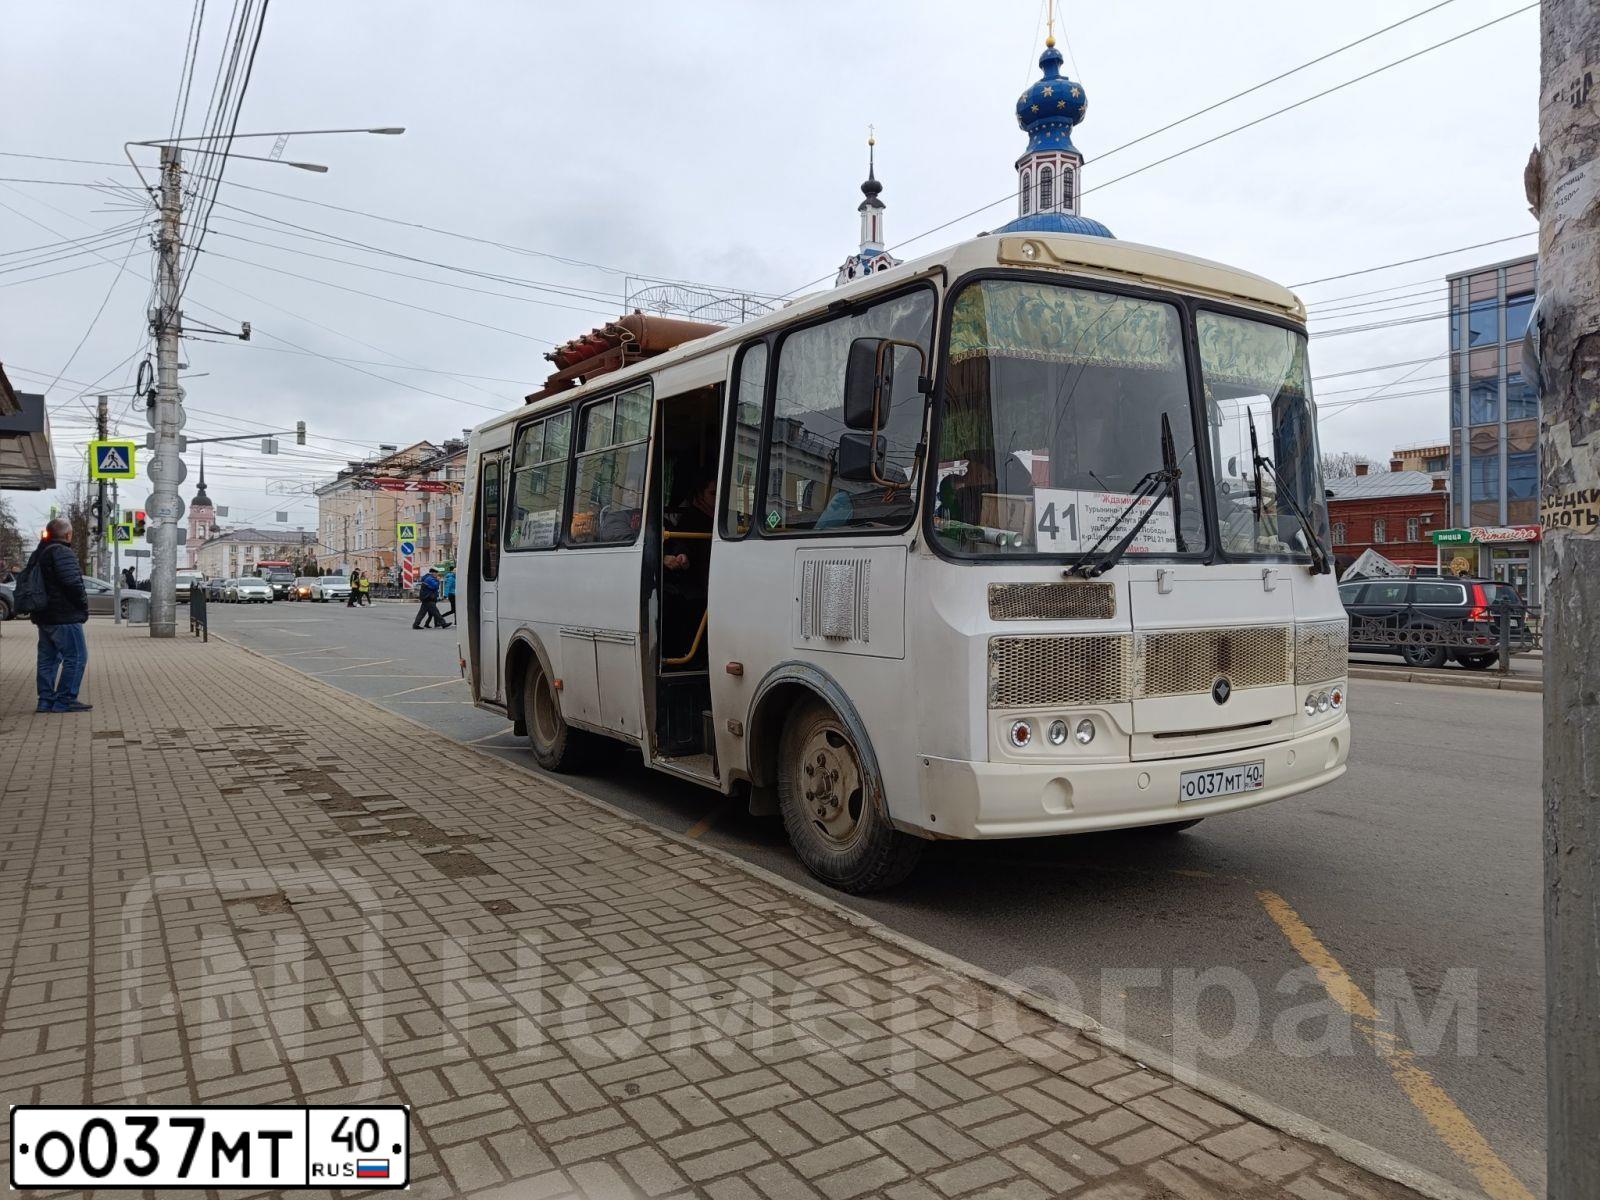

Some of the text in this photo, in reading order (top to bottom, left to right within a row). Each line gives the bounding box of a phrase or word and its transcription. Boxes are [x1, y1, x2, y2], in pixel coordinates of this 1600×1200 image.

[1037, 502, 1078, 541] 41
[1469, 527, 1537, 543] Primavera
[1186, 766, 1260, 797] О037МТ 40
